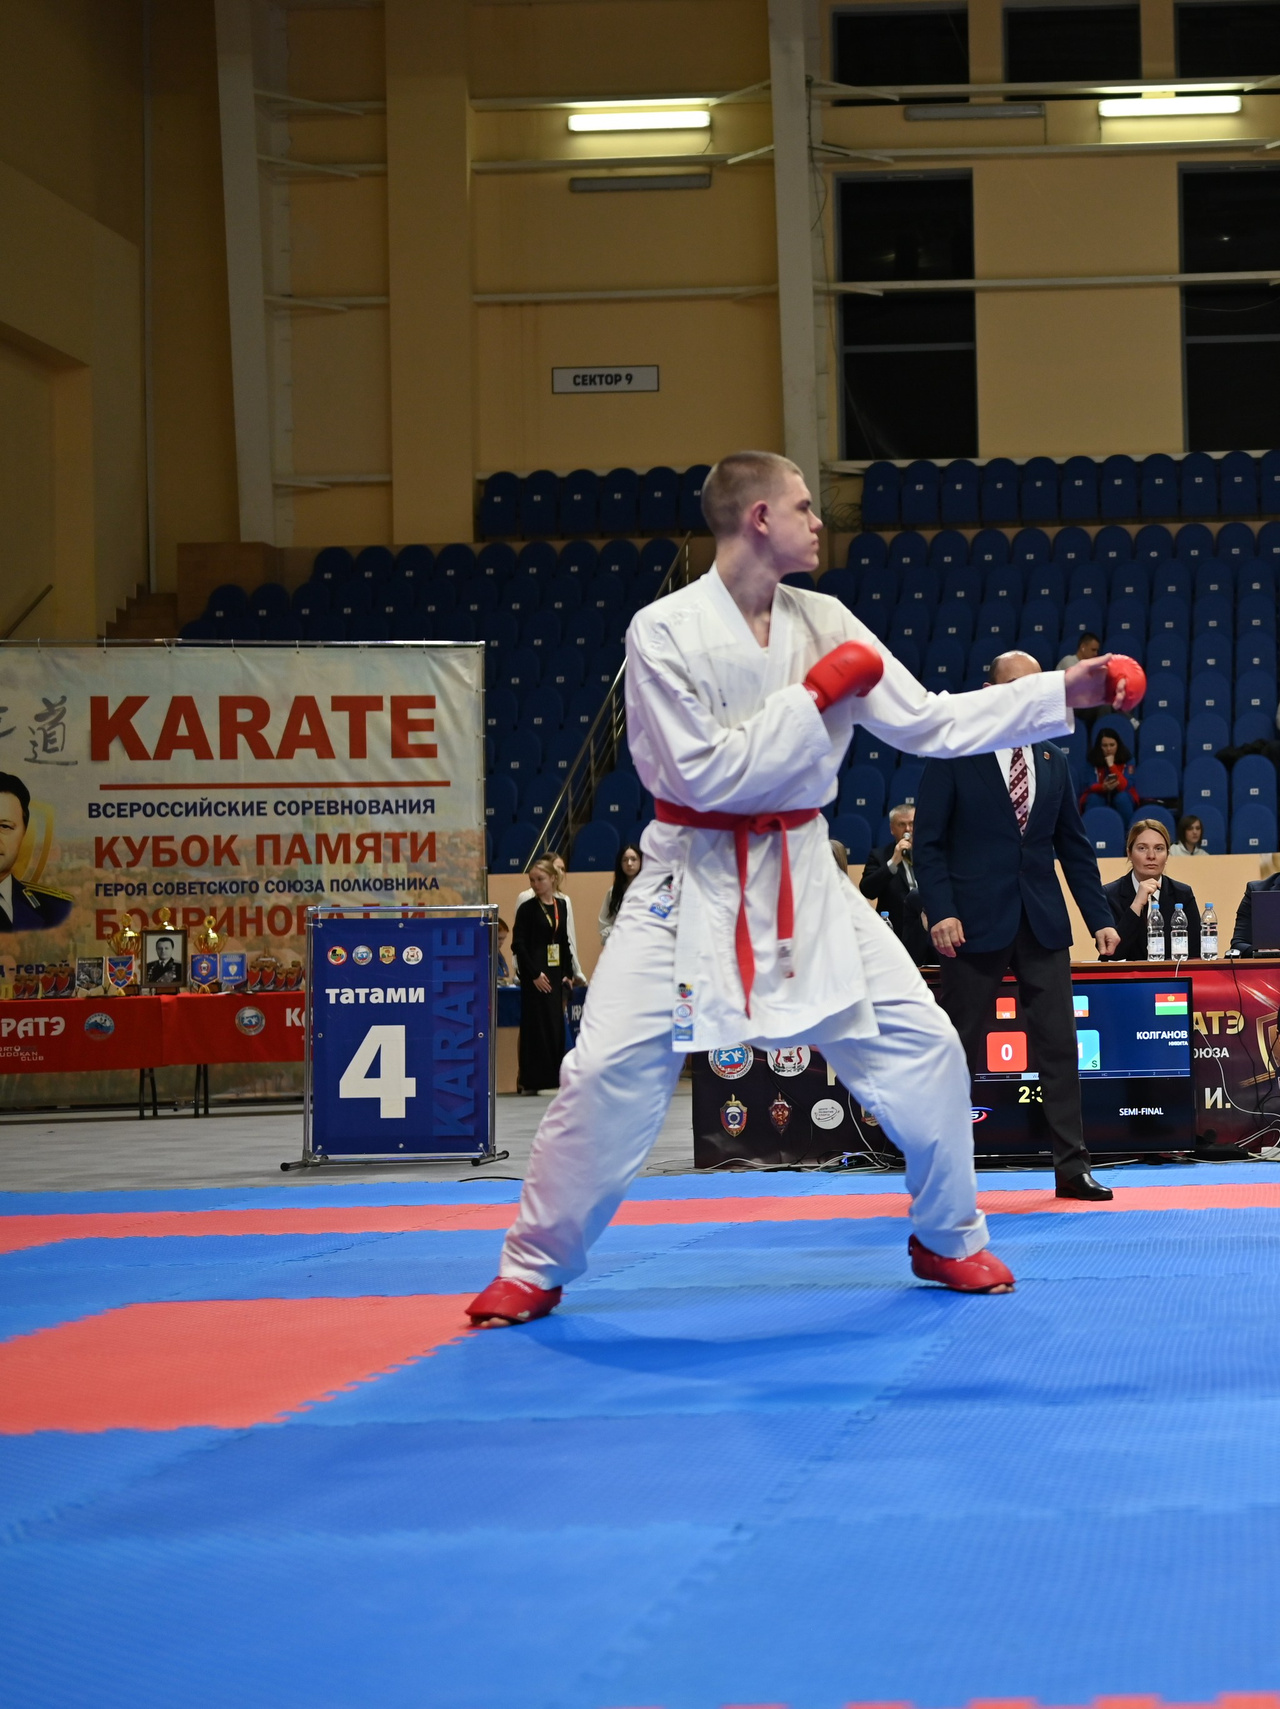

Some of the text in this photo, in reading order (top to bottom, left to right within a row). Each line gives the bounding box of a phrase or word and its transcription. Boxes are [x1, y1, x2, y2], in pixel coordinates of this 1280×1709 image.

[573, 373, 633, 386] СЕКТОР 9
[89, 695, 438, 762] KARATE
[88, 797, 436, 819] ВСЕРОССИЙСКИЕ СОРЕВНОВАНИЯ
[94, 831, 437, 869] КУБОК ПАМЯТИ
[95, 876, 440, 897] ГЕРОЯ СОВЕТСКОГО СОЮЗА ПОЛКОВНИКА
[325, 987, 425, 1004] татами
[433, 927, 475, 1137] KARATE
[1136, 1030, 1188, 1040] КОЛГАНОВ
[1001, 1043, 1013, 1061] 0
[339, 1024, 417, 1119] 4
[1119, 1107, 1164, 1117] SEMI-FINAL
